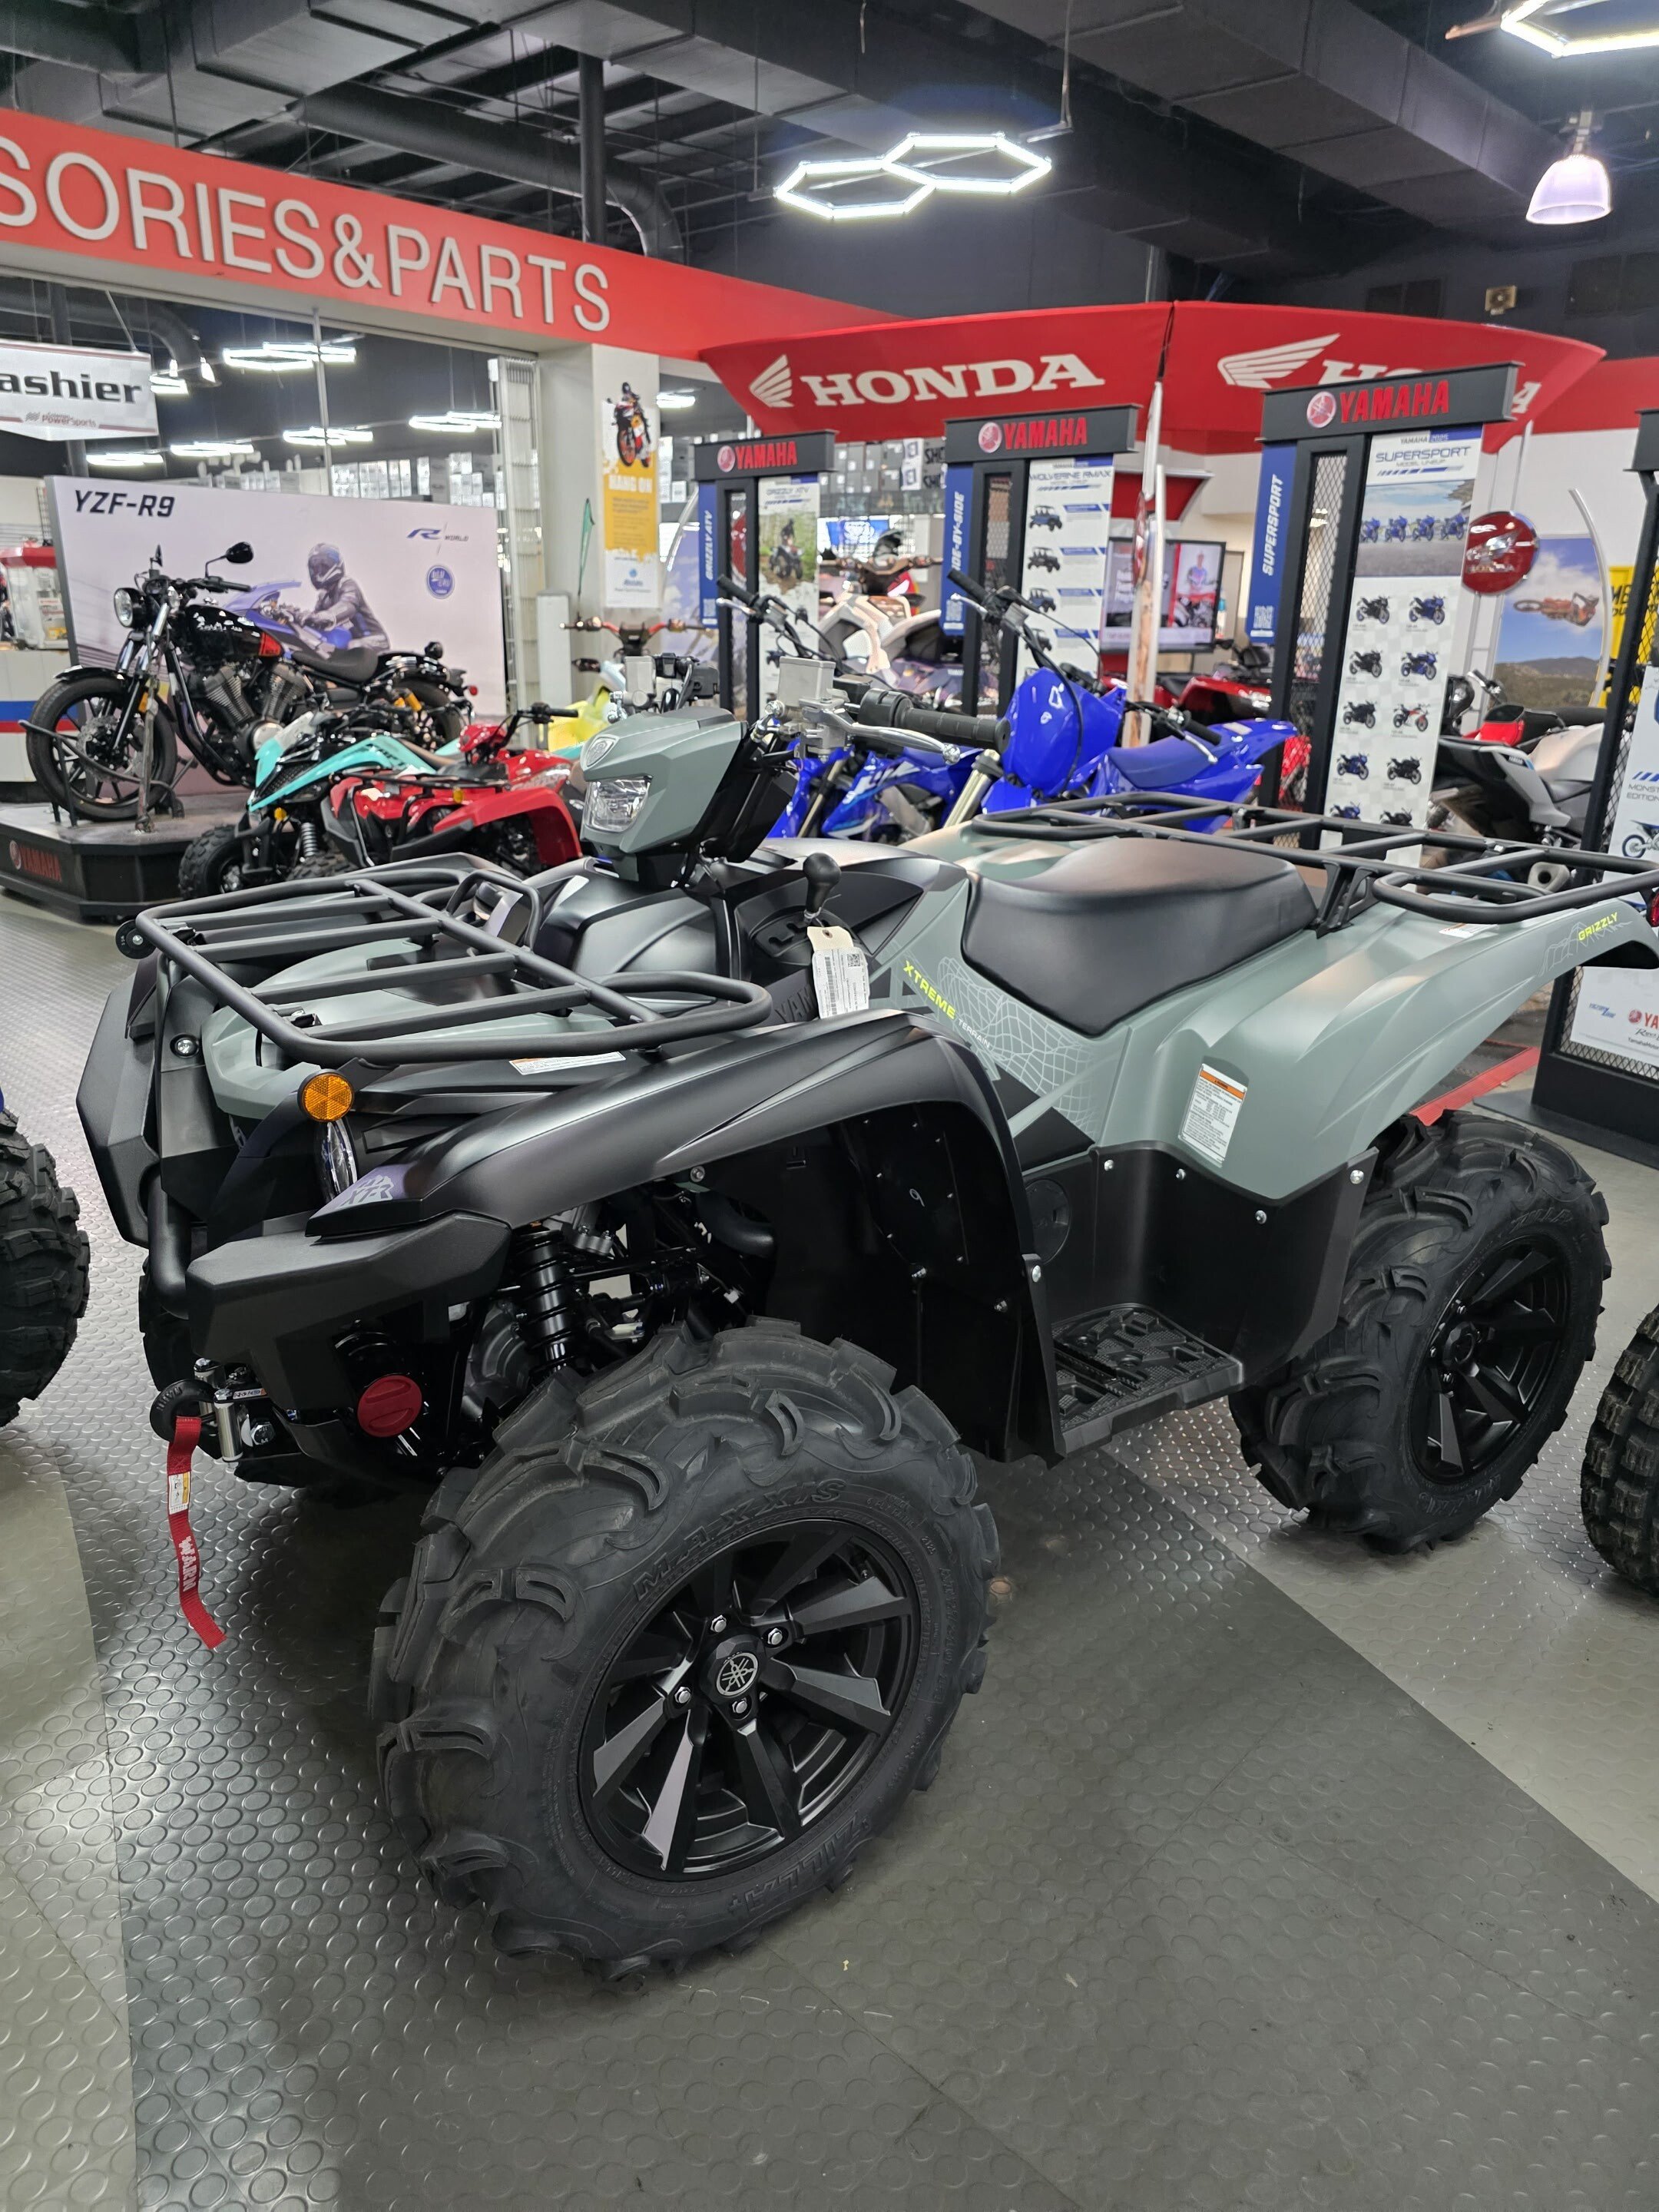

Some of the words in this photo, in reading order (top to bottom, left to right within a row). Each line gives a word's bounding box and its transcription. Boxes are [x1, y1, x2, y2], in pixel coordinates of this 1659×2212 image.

[800, 354, 1105, 406] HONDA
[1340, 381, 1449, 422] YAMAHA
[1003, 417, 1088, 450] YAMAHA
[735, 441, 797, 469] YAMAHA
[1376, 446, 1471, 463] SUPERSPORT
[73, 489, 175, 518] YZF-R9
[951, 492, 965, 571] IDE-BY-SIDE
[1263, 474, 1283, 576] SUPERSPORT
[20, 843, 62, 882] YAMAHA
[1578, 912, 1618, 942] GRIZZLY
[903, 960, 956, 1020] XTREME
[958, 1018, 992, 1049] TERRAIN
[632, 1478, 846, 1601] MAXXIS
[177, 1536, 199, 1592] WARN
